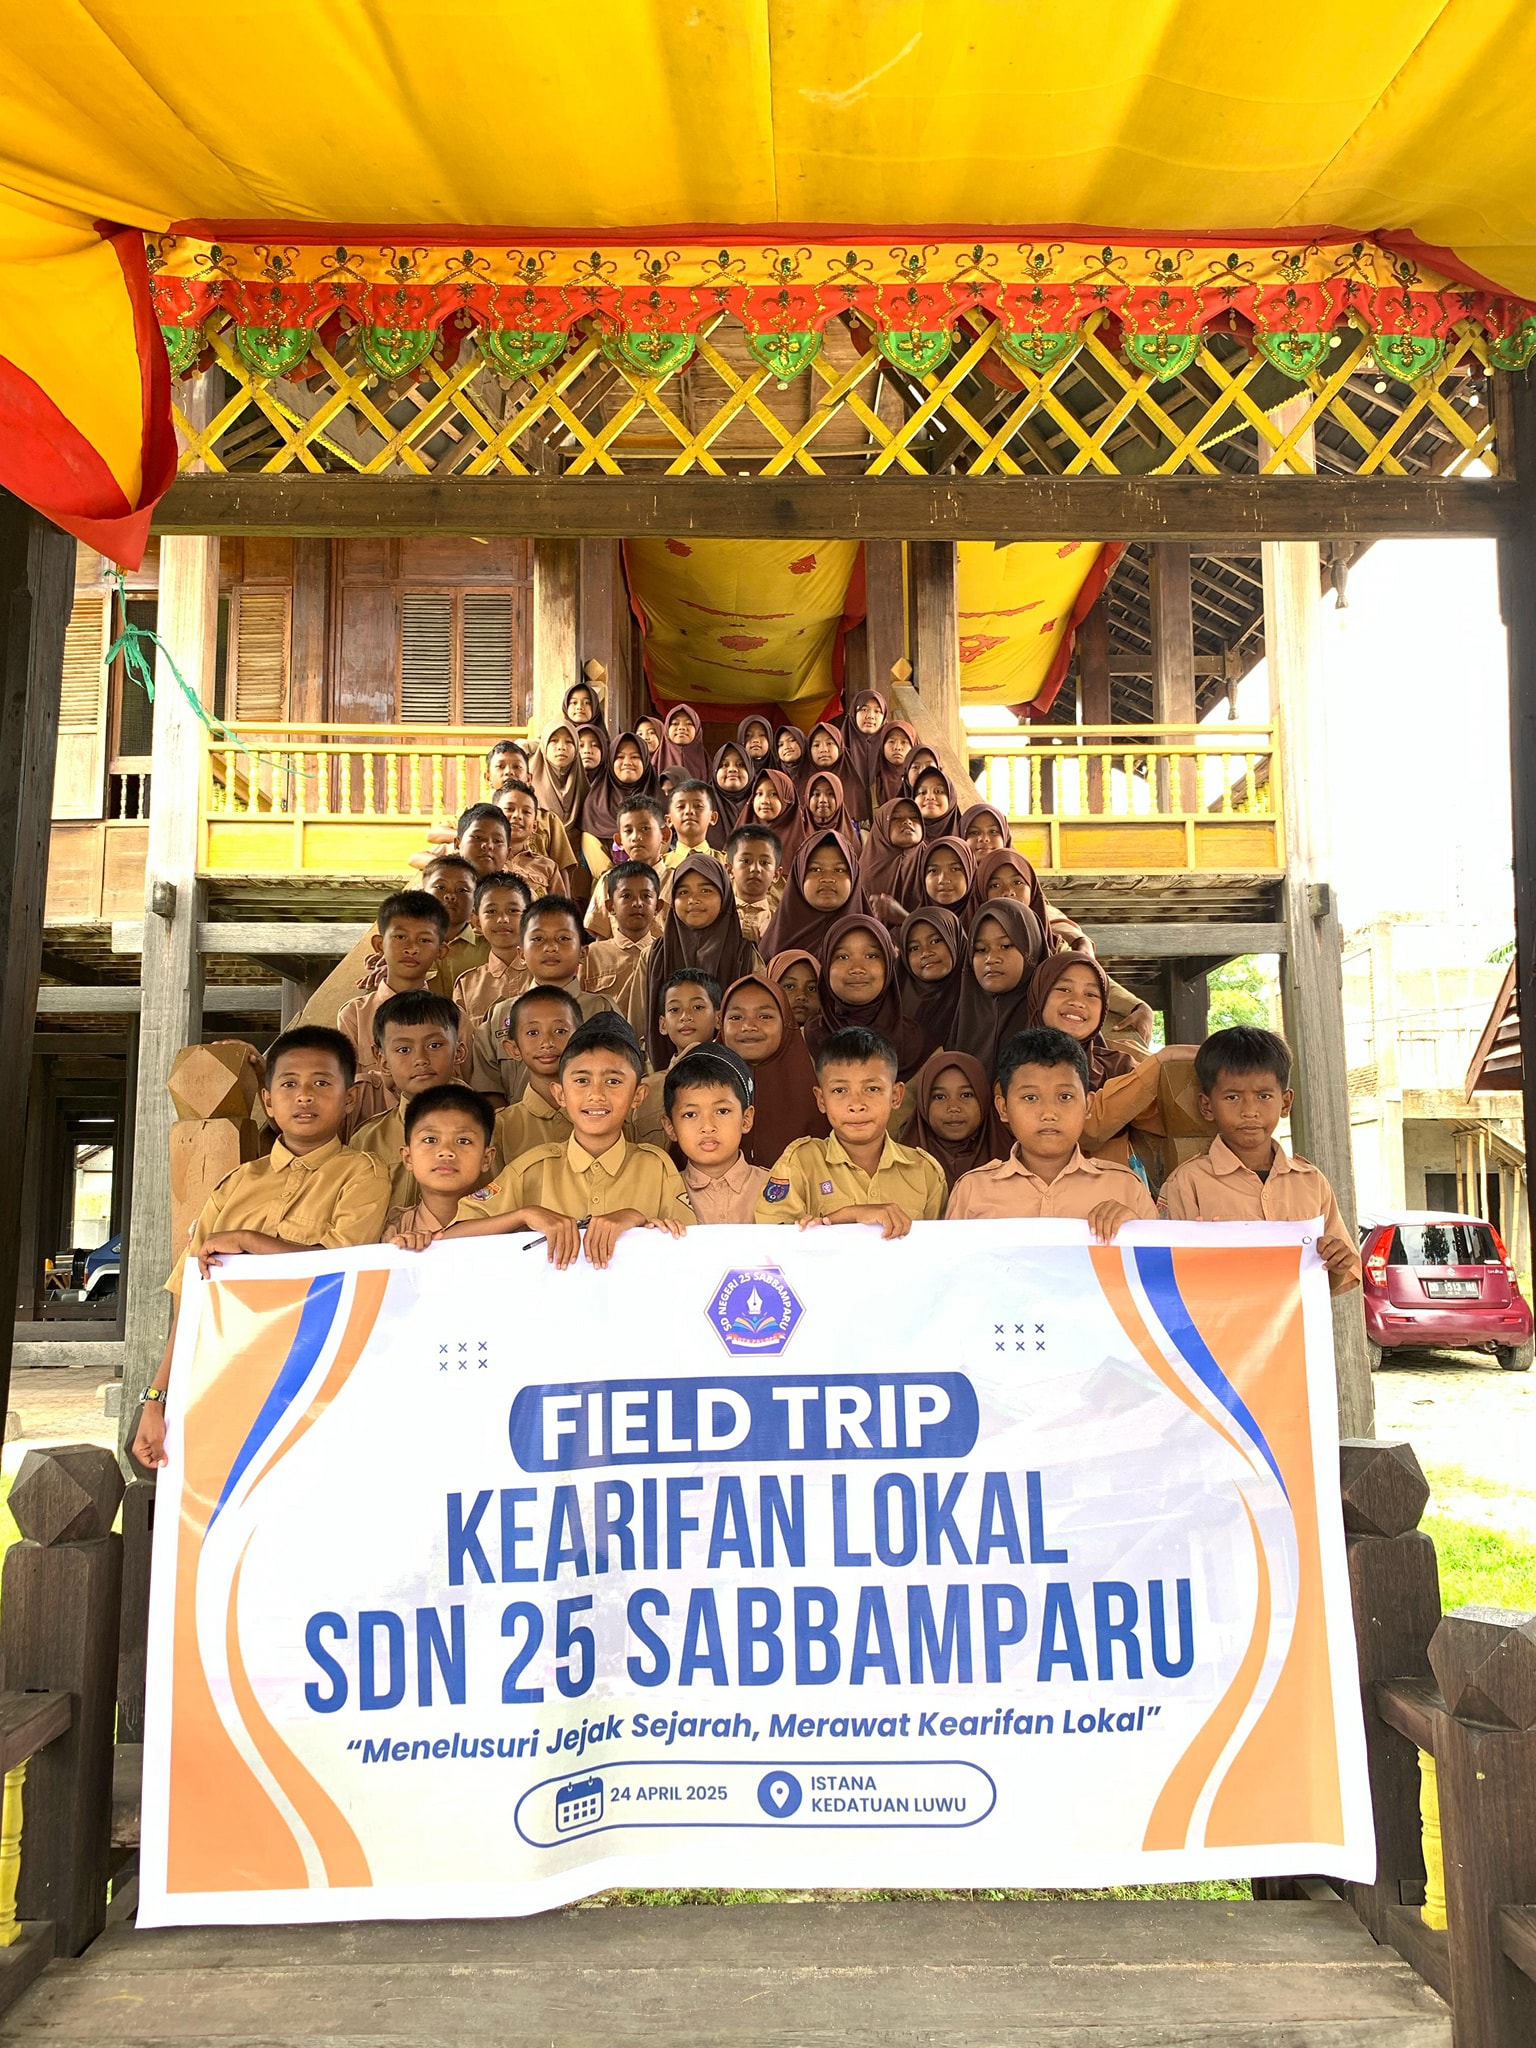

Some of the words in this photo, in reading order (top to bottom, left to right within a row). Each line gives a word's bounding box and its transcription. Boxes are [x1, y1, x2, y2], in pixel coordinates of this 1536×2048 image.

[738, 1272, 751, 1284] 25
[718, 1279, 738, 1315] NEGERI
[753, 1272, 792, 1330] SABBAMPARU
[720, 1317, 732, 1331] SD
[542, 1388, 752, 1461] FIELD
[772, 1384, 951, 1450] TRIP
[446, 1475, 806, 1586] KEARIFAN
[833, 1471, 1068, 1567] LOKAL
[304, 1605, 467, 1714] SDN
[500, 1594, 596, 1704] 25
[626, 1578, 1195, 1687] SABBAMPARU
[546, 1715, 624, 1755] Jejak
[631, 1712, 760, 1746] Sejarah,
[769, 1713, 910, 1738] Merawat
[918, 1709, 1054, 1737] Kearifan
[610, 1788, 632, 1802] 24
[636, 1786, 682, 1801] APRIL
[686, 1785, 728, 1801] 2025
[810, 1776, 877, 1791] ISTANA
[811, 1797, 909, 1813] KEDATUAN
[913, 1797, 967, 1812] LUWU
